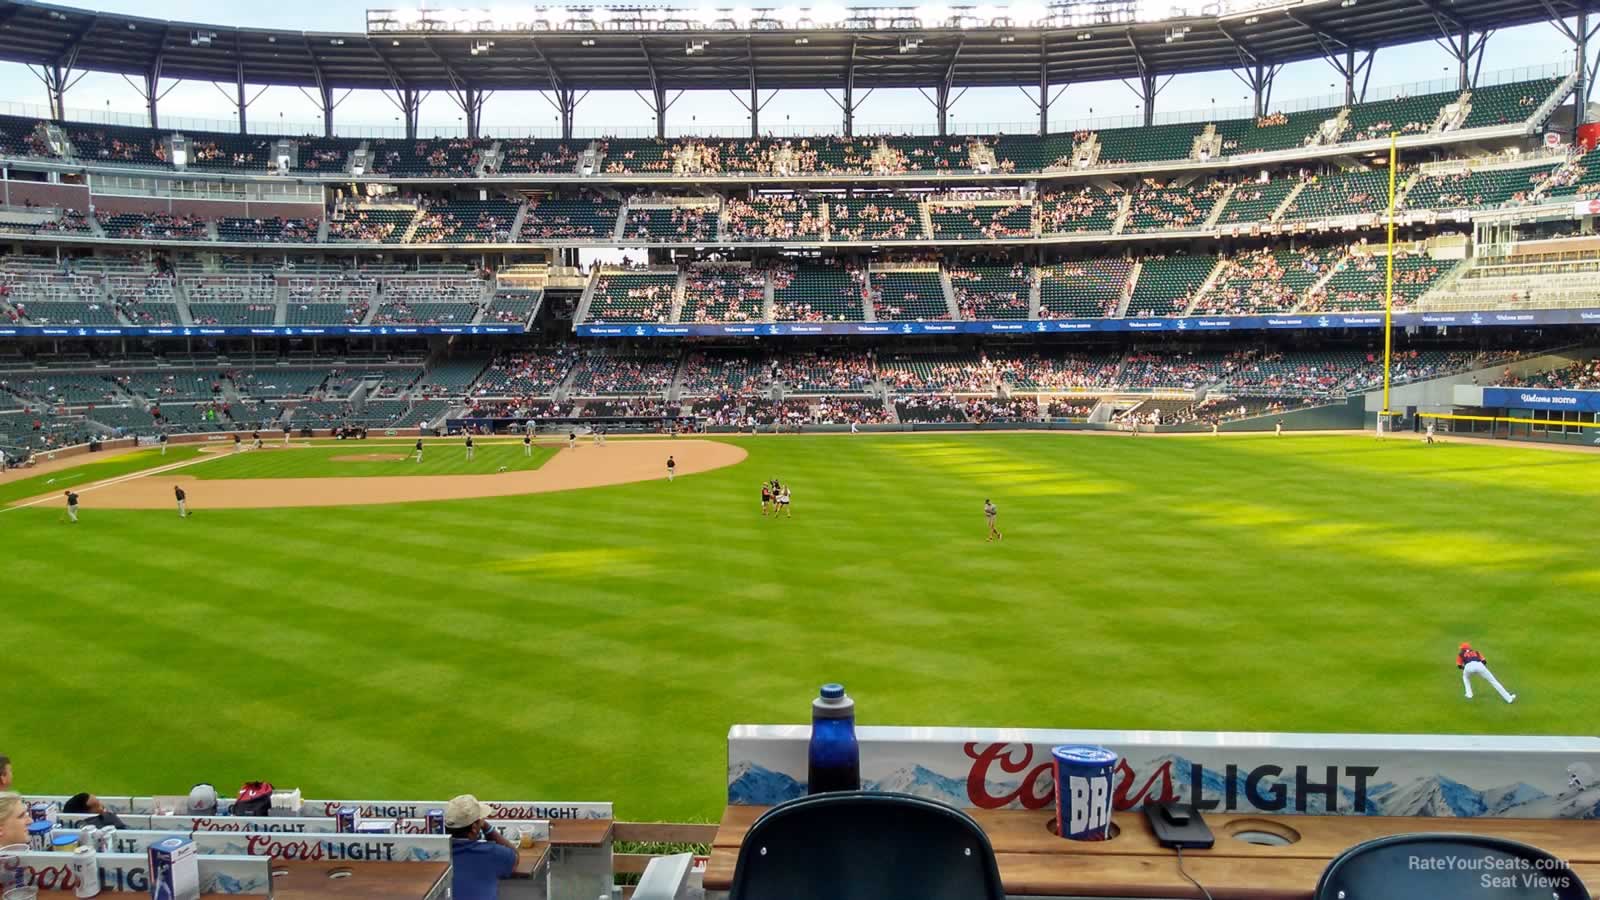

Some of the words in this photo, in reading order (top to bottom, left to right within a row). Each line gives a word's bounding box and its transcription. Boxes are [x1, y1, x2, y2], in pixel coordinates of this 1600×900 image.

[963, 741, 1180, 810] Cors
[1191, 763, 1379, 813] LIGHT
[375, 806, 417, 818] LIGHT
[536, 807, 578, 819] LIGHT
[246, 835, 324, 860] Coors
[327, 842, 394, 860] LIGHT
[98, 866, 149, 892] LIG
